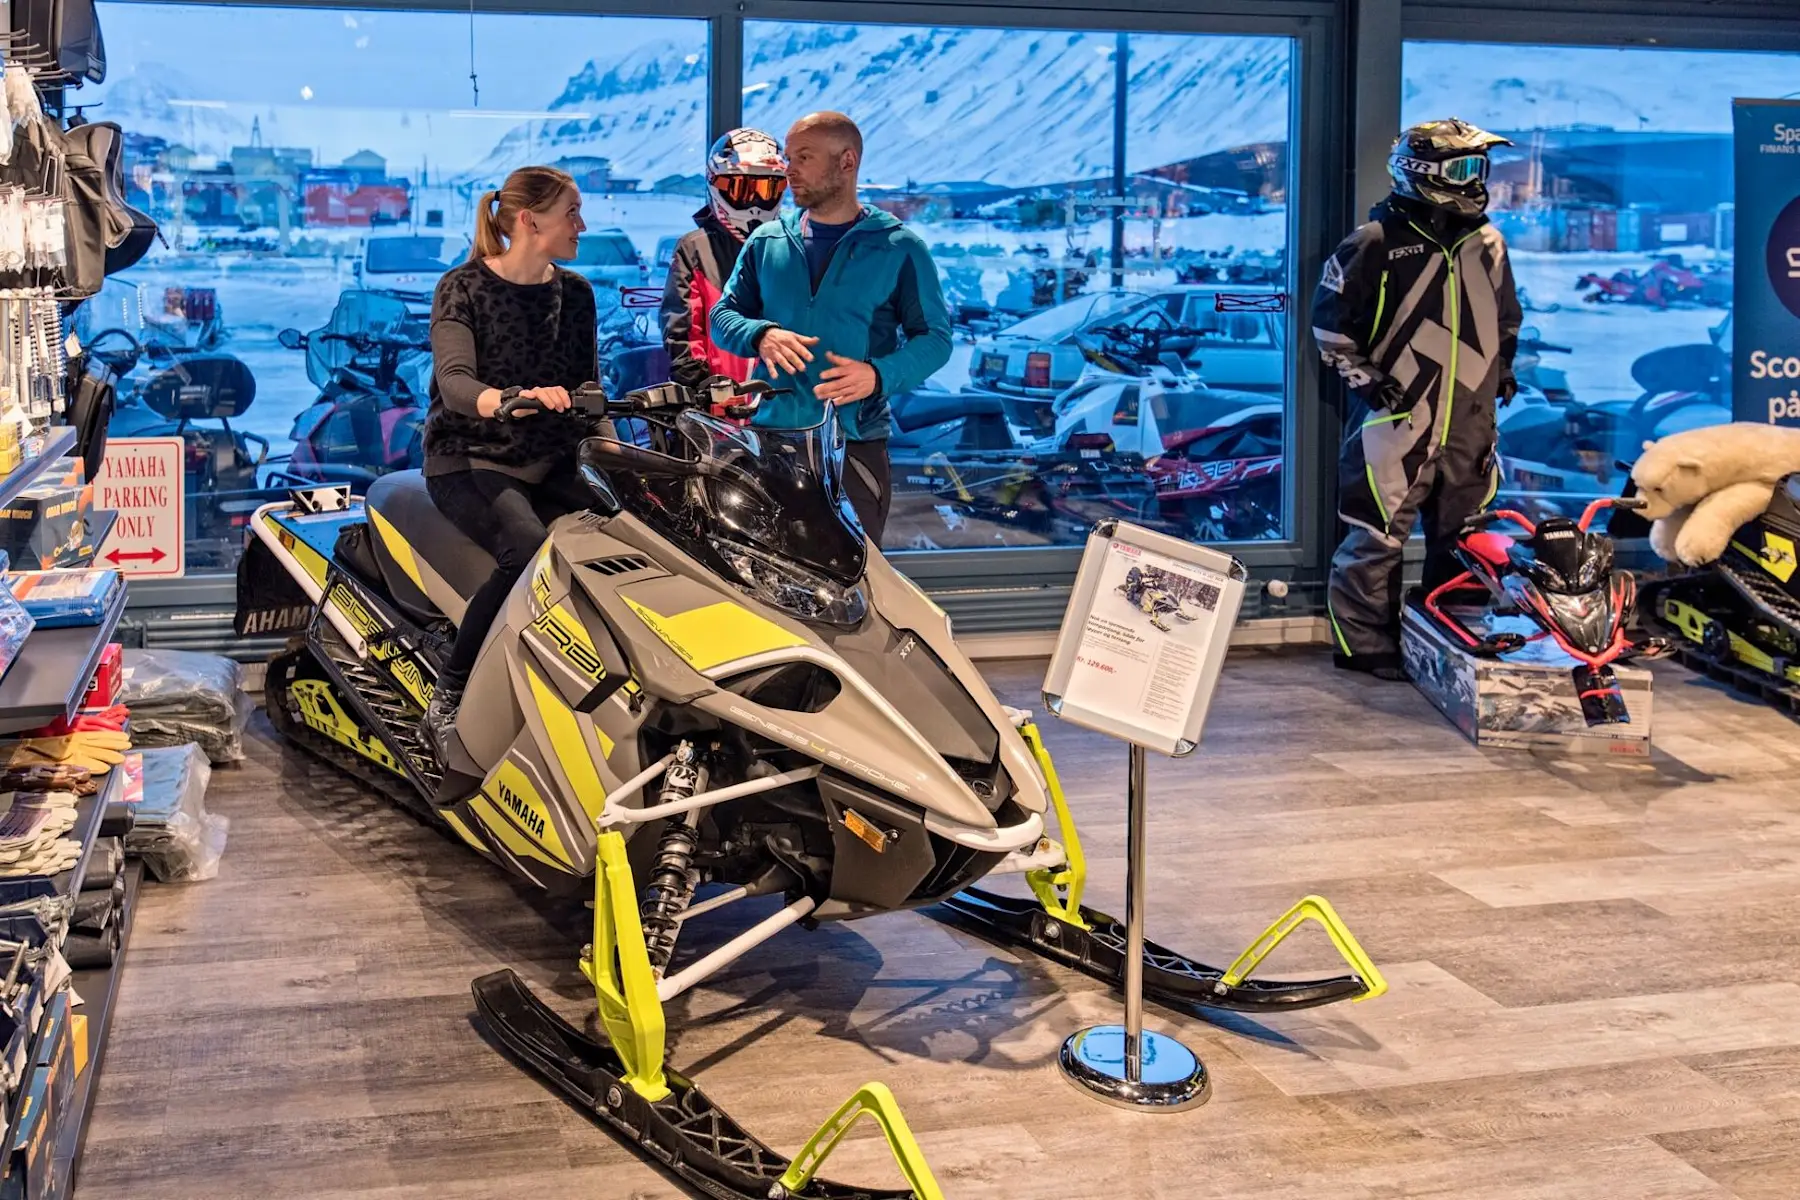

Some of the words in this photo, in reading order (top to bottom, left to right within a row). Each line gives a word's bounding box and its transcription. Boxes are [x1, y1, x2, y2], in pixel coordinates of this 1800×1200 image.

[1760, 144, 1795, 153] FINANS
[1395, 157, 1431, 172] FXR
[1388, 244, 1424, 260] FXR
[1750, 350, 1800, 378] Sco
[1768, 390, 1800, 424] på
[105, 456, 166, 478] YAMAHA
[104, 485, 168, 508] PARKING
[117, 516, 155, 539] ONLY
[1544, 530, 1575, 540] YAMAHA
[729, 705, 810, 746] GENESIS
[810, 742, 825, 753] 4
[827, 750, 911, 793] STROKE
[498, 780, 545, 839] YAMAHA
